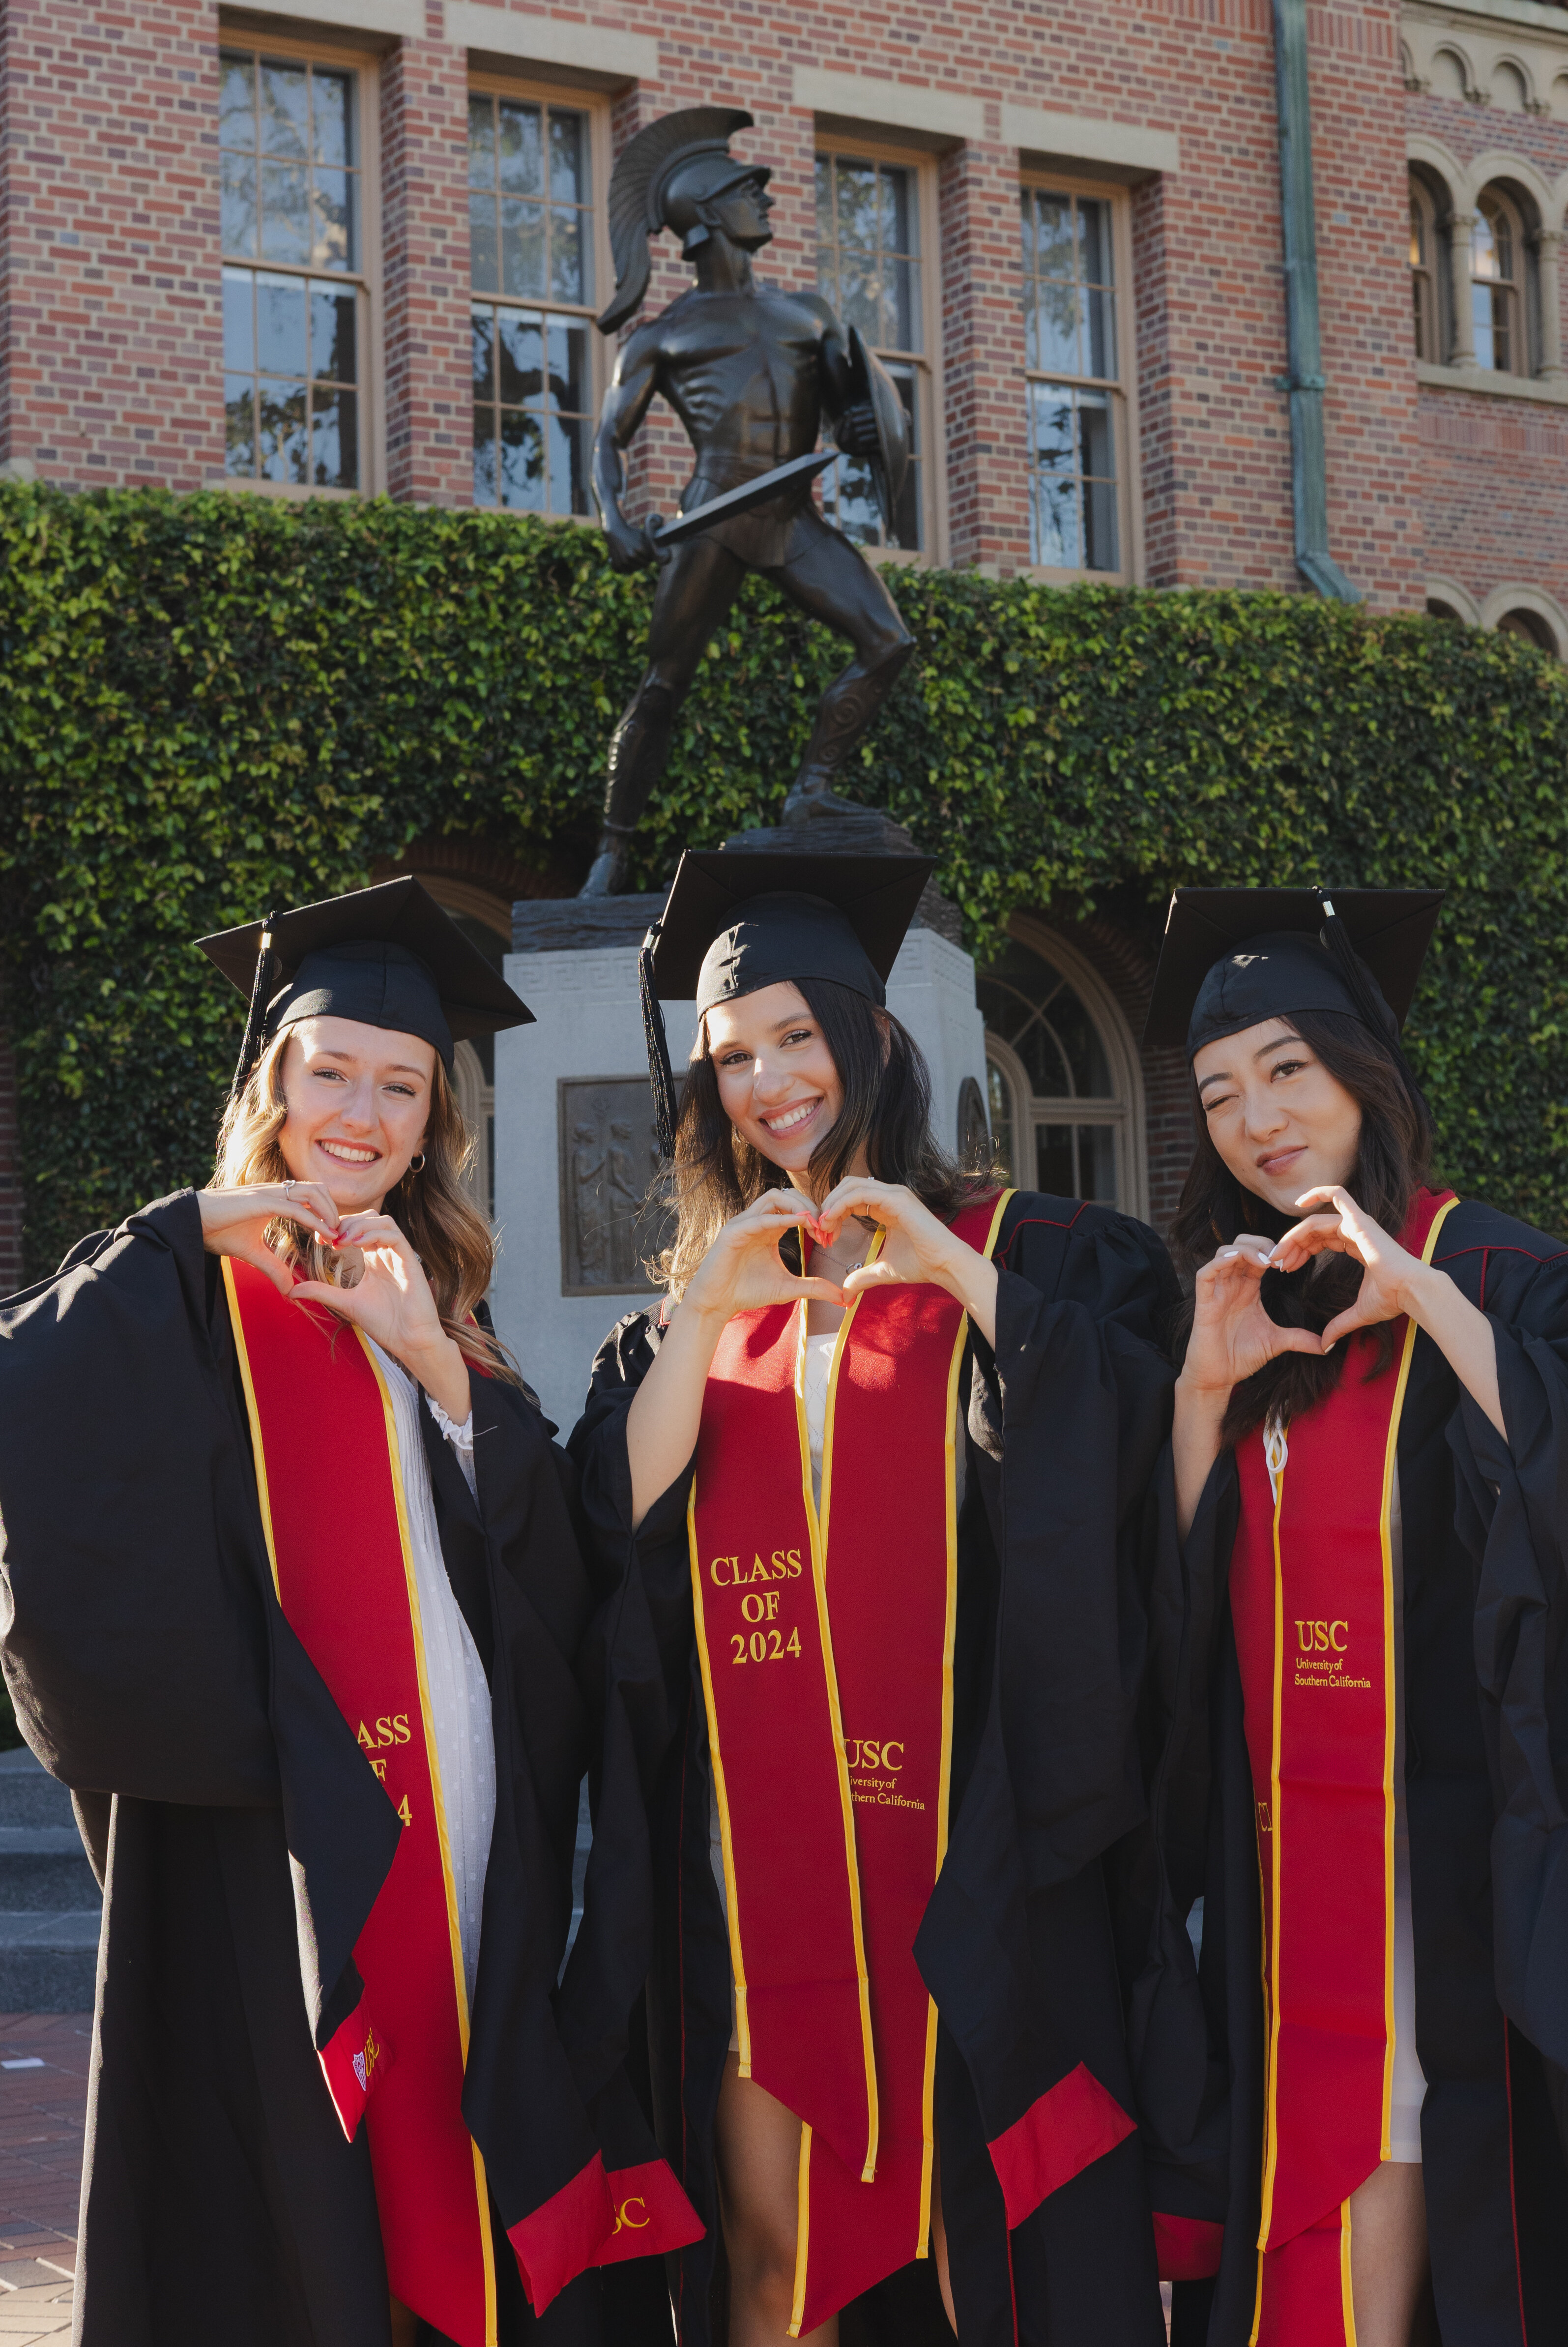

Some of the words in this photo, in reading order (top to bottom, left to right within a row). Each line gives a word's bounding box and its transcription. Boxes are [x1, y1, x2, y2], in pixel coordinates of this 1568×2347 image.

[710, 1549, 802, 1586] CLASS
[741, 1591, 780, 1623] OF
[730, 1627, 802, 1664] 2024
[1294, 1620, 1348, 1651] USC
[1295, 1673, 1327, 1686] Southern
[1329, 1675, 1371, 1688] California
[1296, 1657, 1334, 1673] University
[1334, 1658, 1343, 1670] of
[357, 1714, 411, 1749] ASS
[849, 1776, 885, 1791] iversity
[885, 1778, 897, 1789] of
[851, 1791, 875, 1803] thern
[877, 1792, 925, 1810] California
